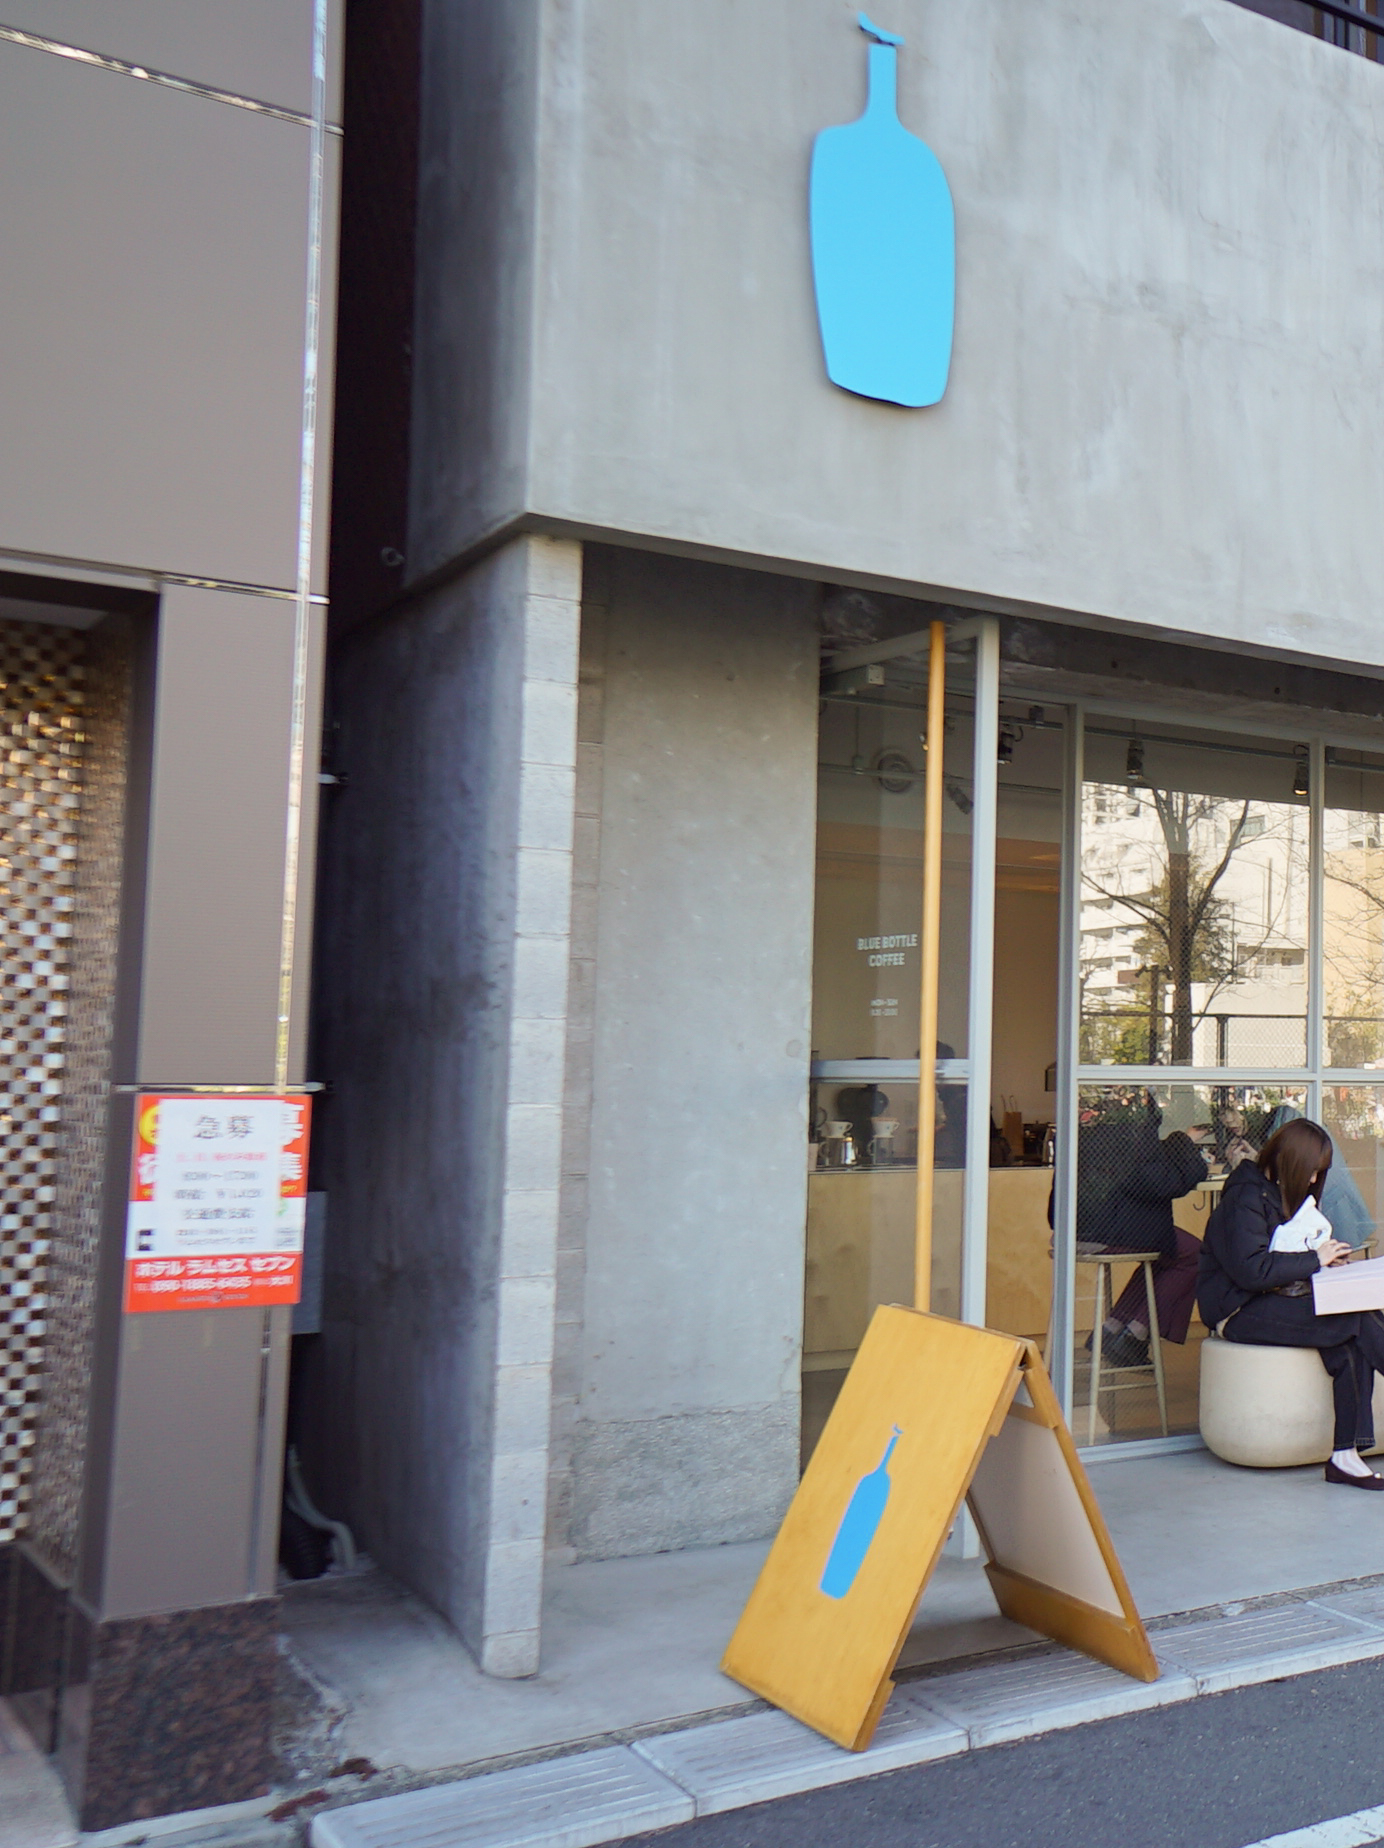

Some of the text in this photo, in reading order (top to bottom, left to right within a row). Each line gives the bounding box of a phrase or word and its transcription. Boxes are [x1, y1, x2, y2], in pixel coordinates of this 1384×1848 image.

[857, 934, 918, 950] BLUE BOTTLE
[868, 952, 905, 967] COFFEE
[136, 1260, 185, 1277] ホテル
